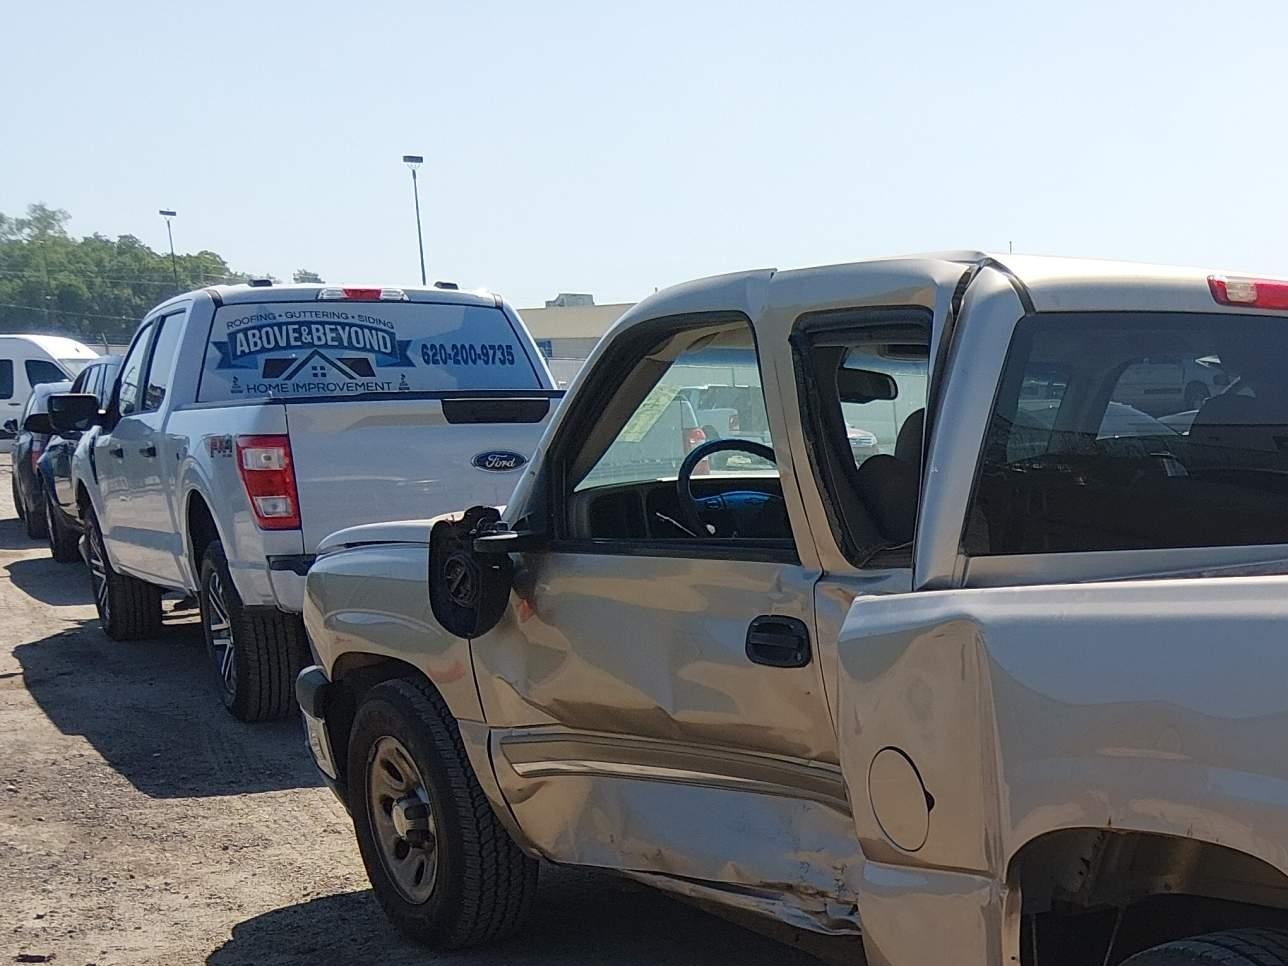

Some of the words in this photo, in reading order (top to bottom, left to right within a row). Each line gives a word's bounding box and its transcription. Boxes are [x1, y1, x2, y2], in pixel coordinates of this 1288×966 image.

[226, 312, 276, 330] ROOFING
[285, 310, 349, 321] GUTTERING
[357, 315, 393, 330] SIDING
[421, 343, 514, 365] 620-200-9735
[247, 382, 290, 393] HOME
[292, 381, 392, 393] IMPROVEMENT
[486, 454, 516, 468] Ford
